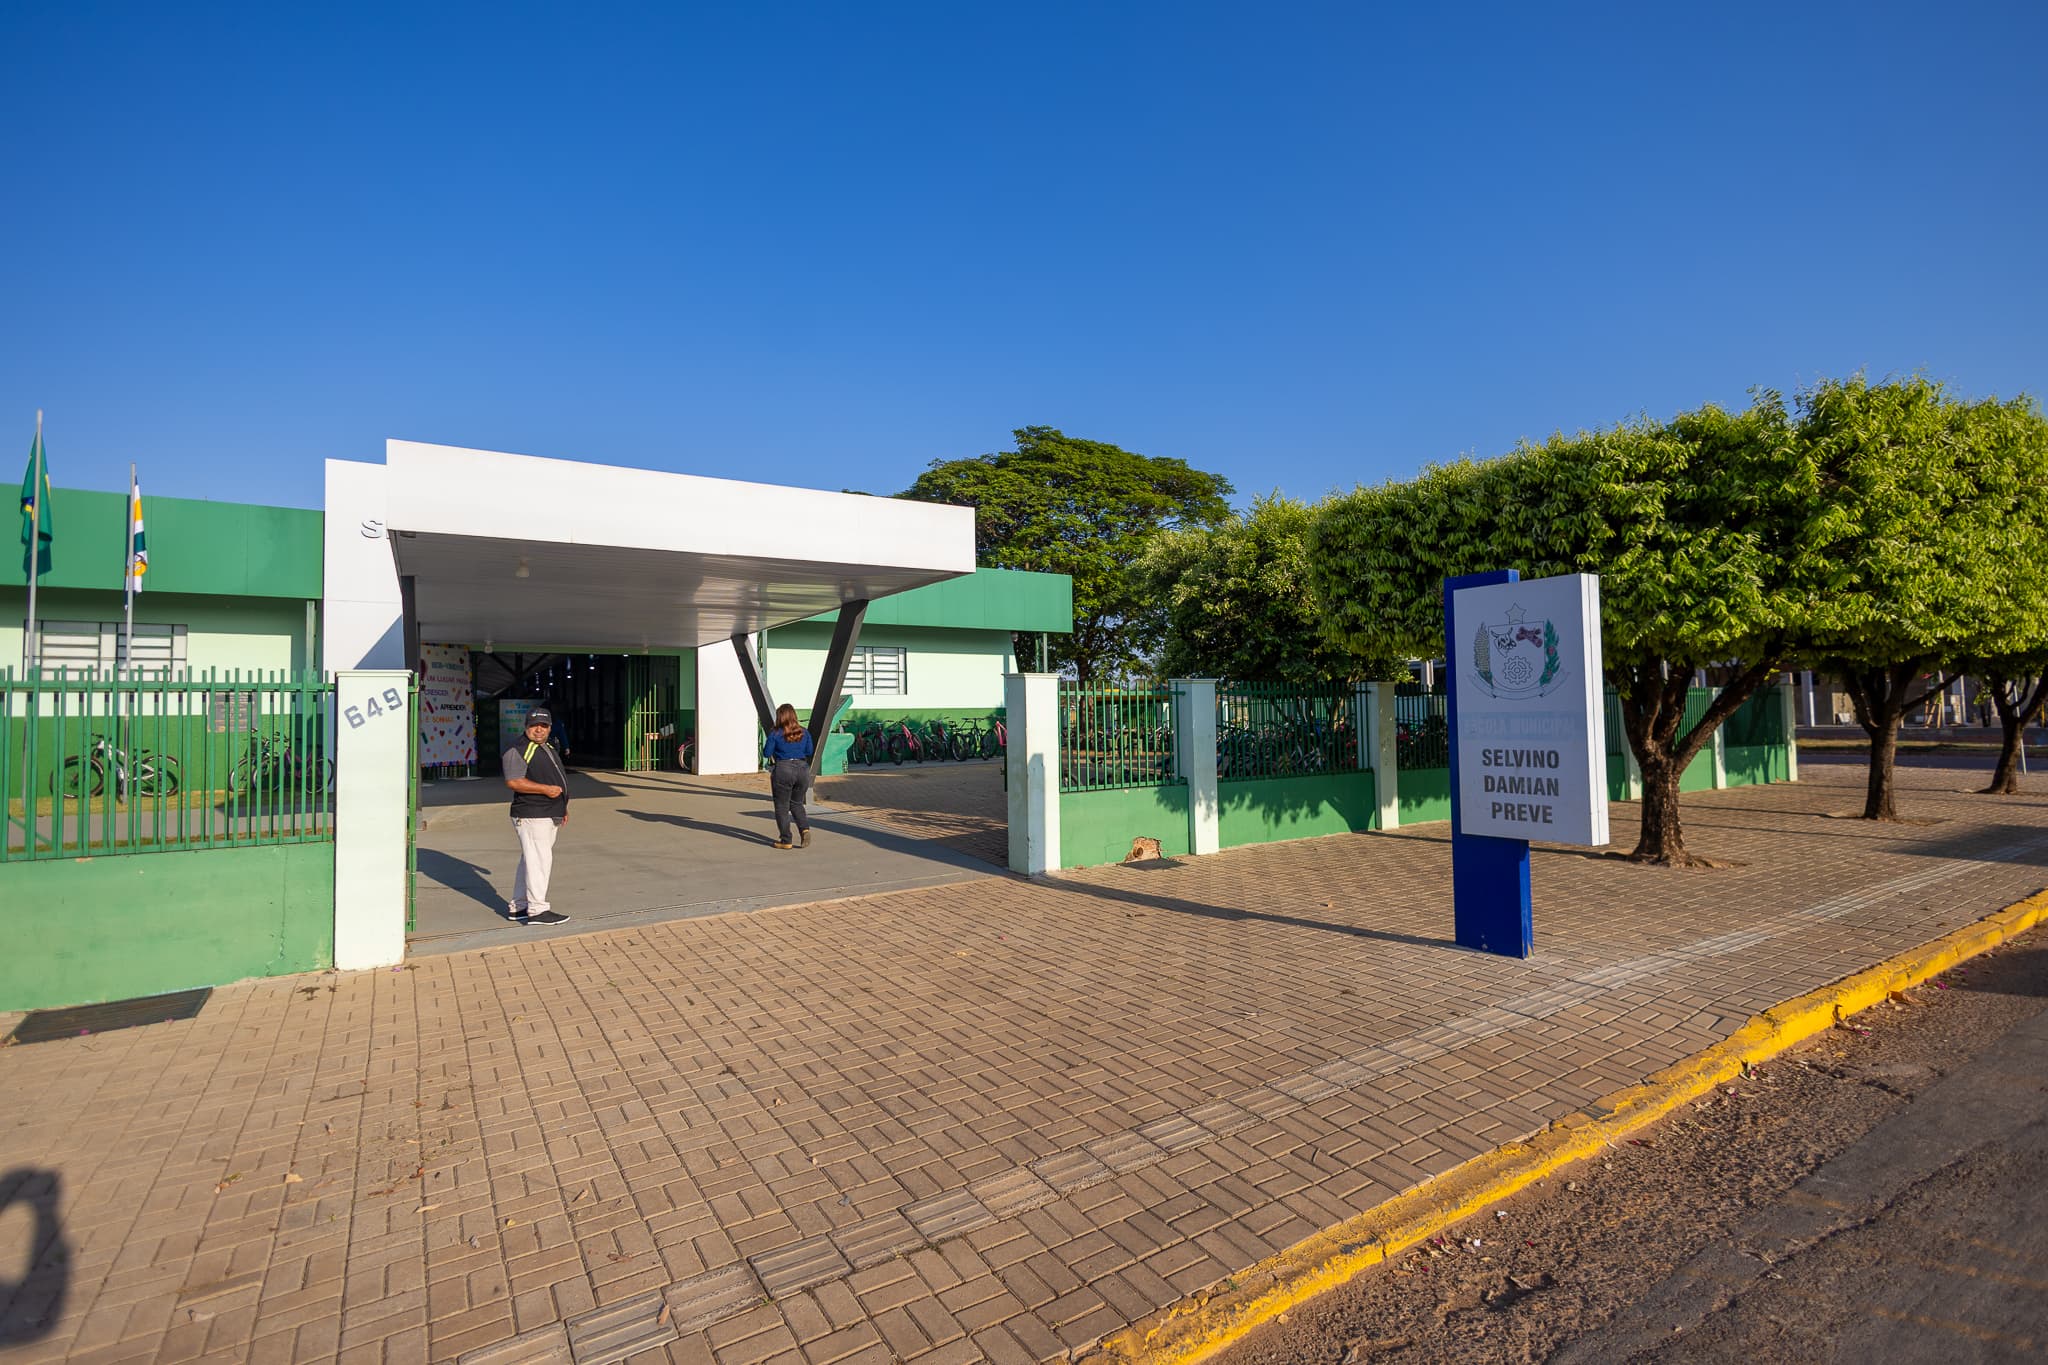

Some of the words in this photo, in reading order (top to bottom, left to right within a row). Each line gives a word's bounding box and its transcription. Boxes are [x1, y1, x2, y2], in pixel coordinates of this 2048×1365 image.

[360, 517, 391, 539] S
[344, 687, 403, 729] 649
[1482, 748, 1559, 769] SELVINO
[1484, 775, 1559, 796] DAMIAN
[1491, 802, 1553, 824] PREVE
